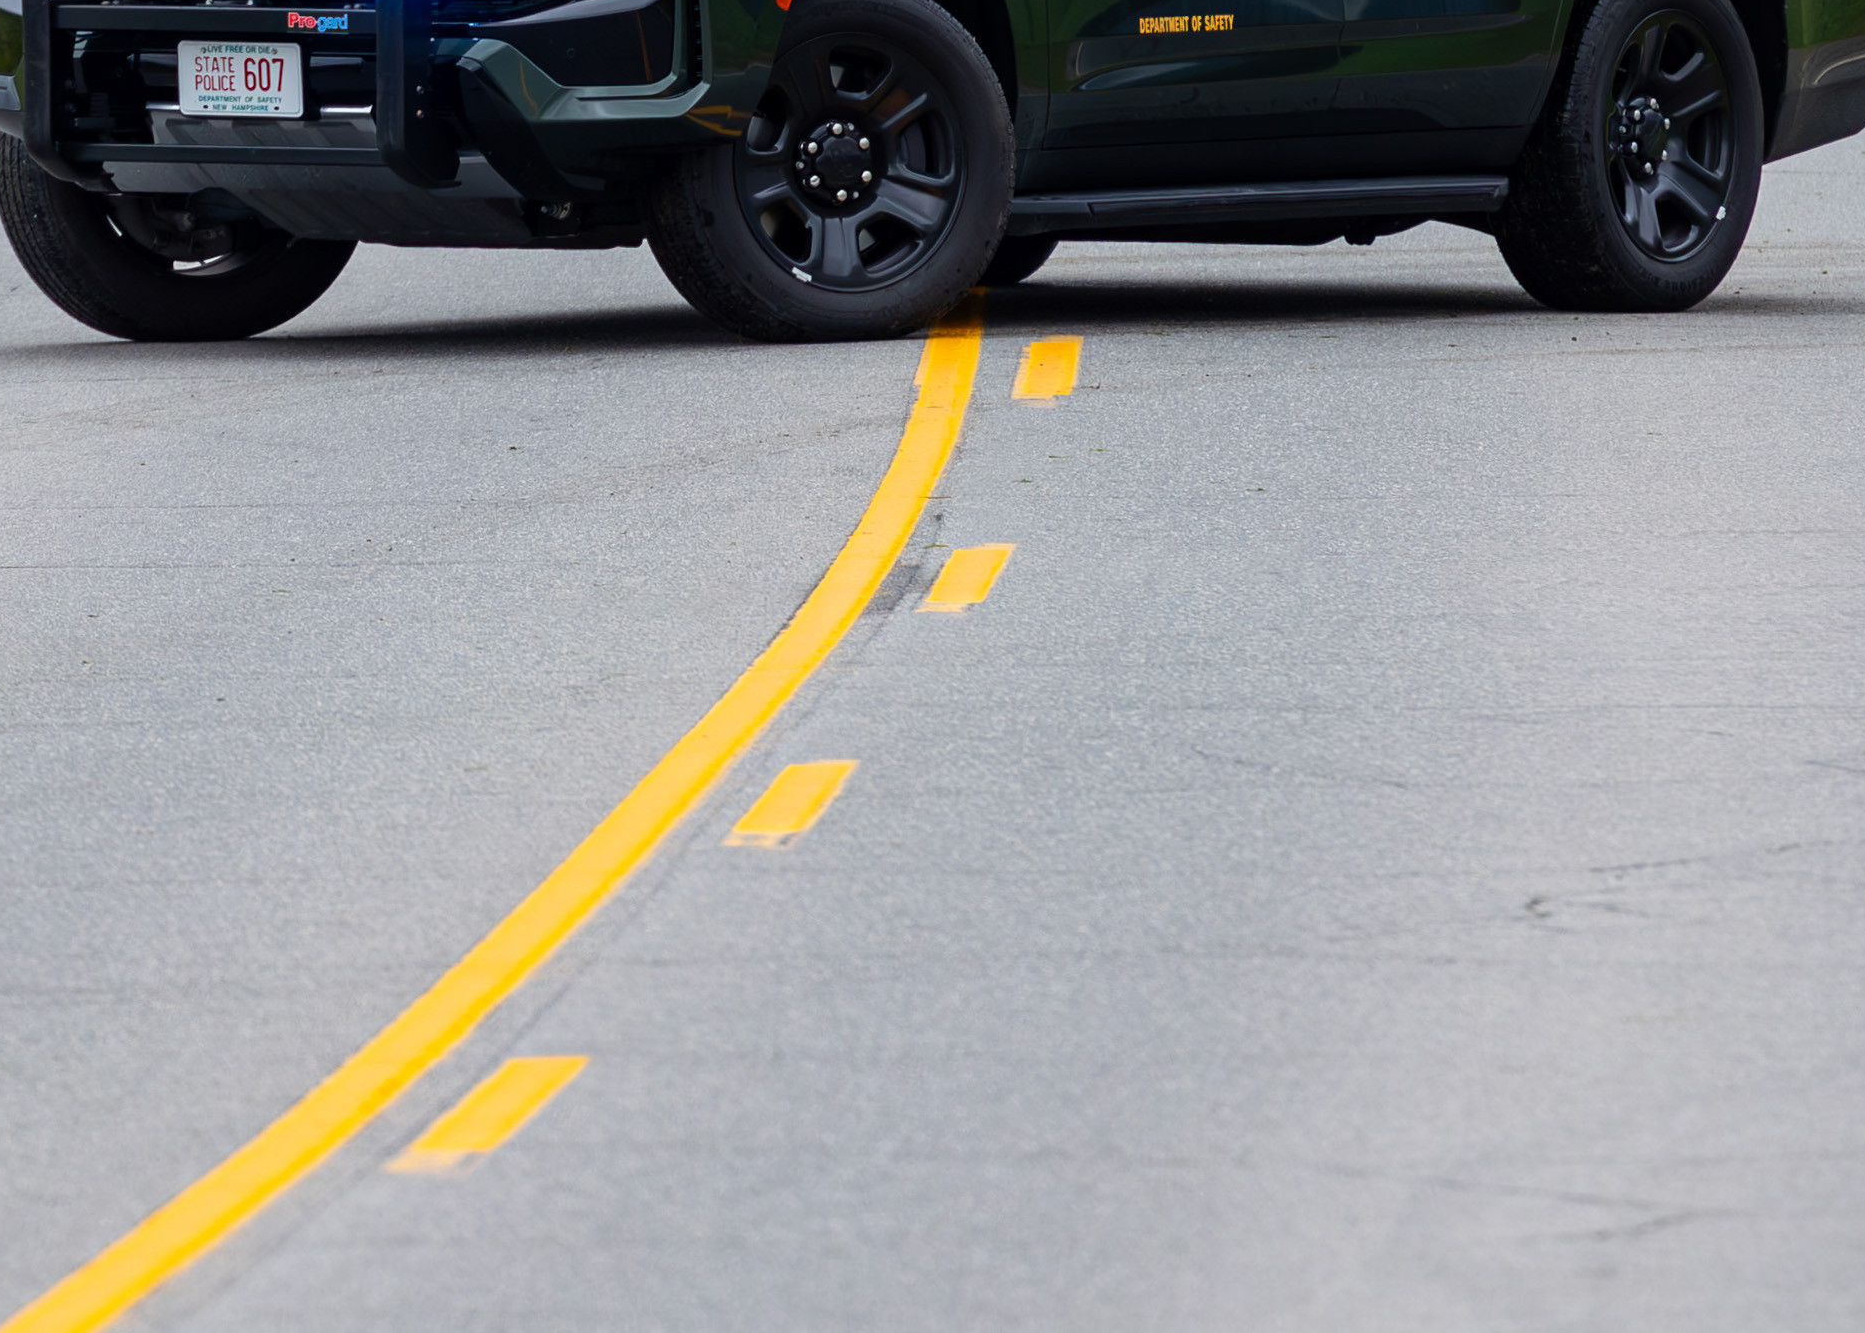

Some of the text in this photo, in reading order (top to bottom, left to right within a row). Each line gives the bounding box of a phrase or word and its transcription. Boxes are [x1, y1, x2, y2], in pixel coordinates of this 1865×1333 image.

[1139, 14, 1234, 34] DEPARTMENT OF SAFETY
[207, 45, 271, 54] LIVE FREE OR DIE
[195, 56, 235, 73] STATE
[195, 74, 236, 92] POLICE
[244, 57, 284, 92] 607
[198, 95, 242, 103] DEPARTMENT
[257, 96, 283, 104] SAFETY
[231, 104, 269, 112] HAMPSHIRE
